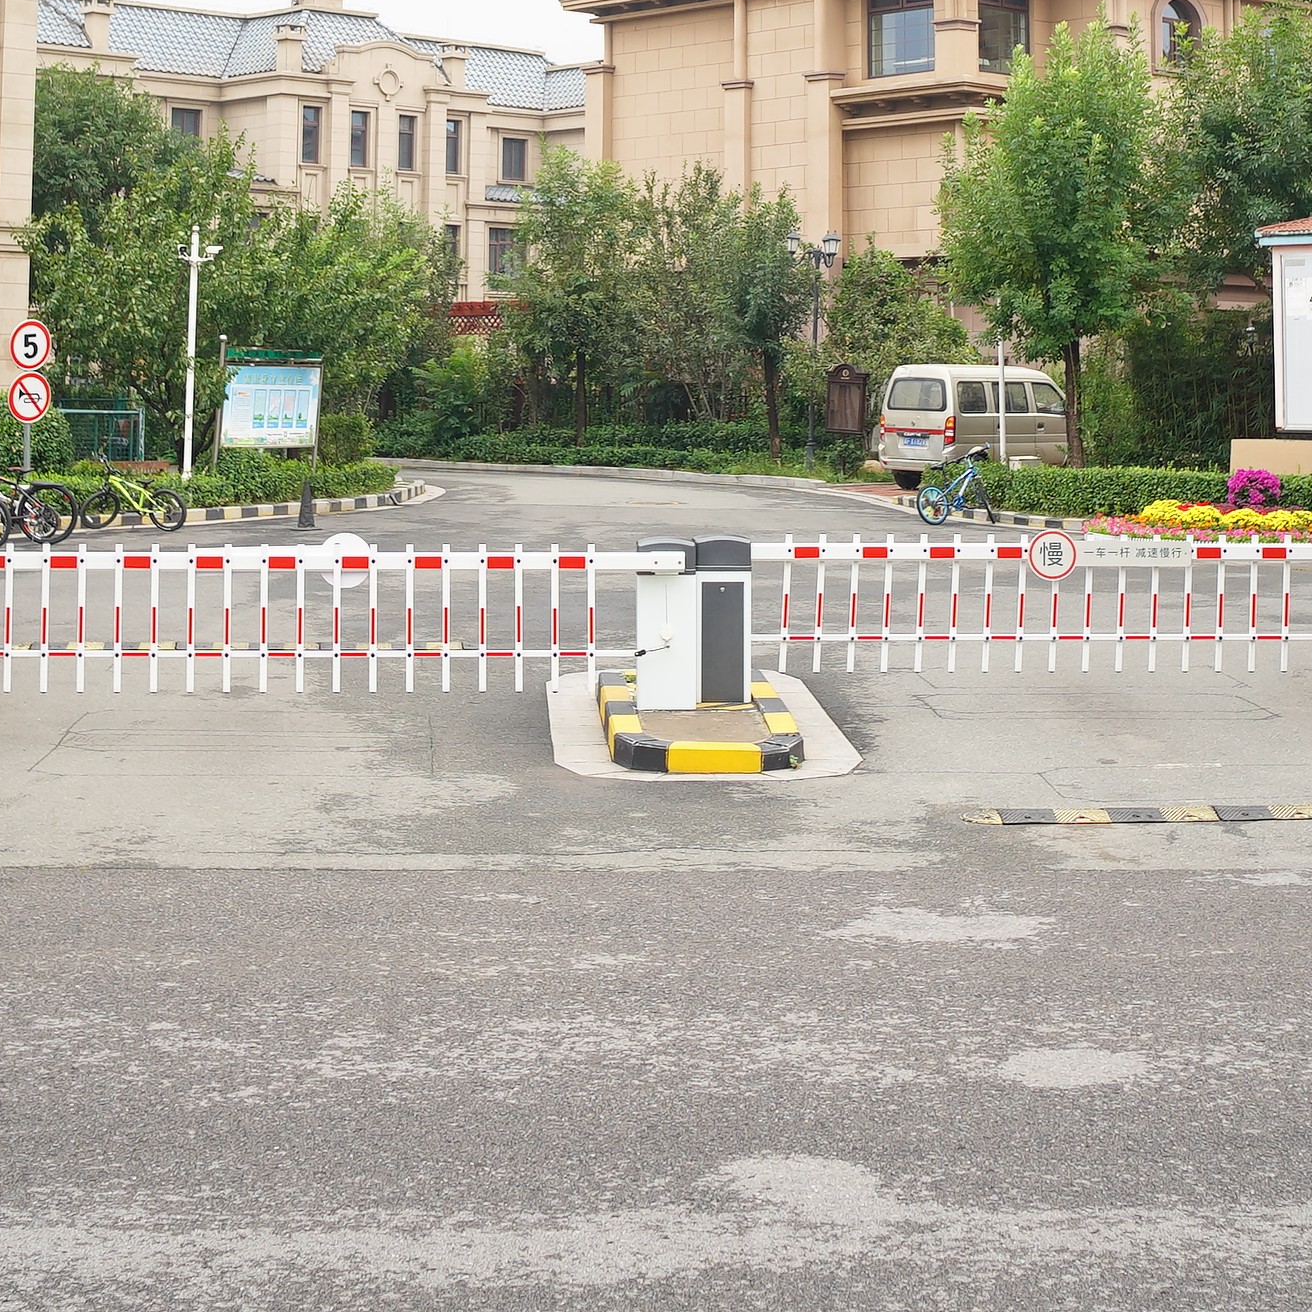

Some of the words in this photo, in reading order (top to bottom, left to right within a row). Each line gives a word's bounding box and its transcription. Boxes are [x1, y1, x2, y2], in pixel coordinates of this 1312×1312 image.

[24, 333, 38, 358] 5
[1039, 541, 1064, 567] 慢
[1083, 546, 1131, 559] 一车一杆
[1135, 546, 1183, 560] 减速慢行
